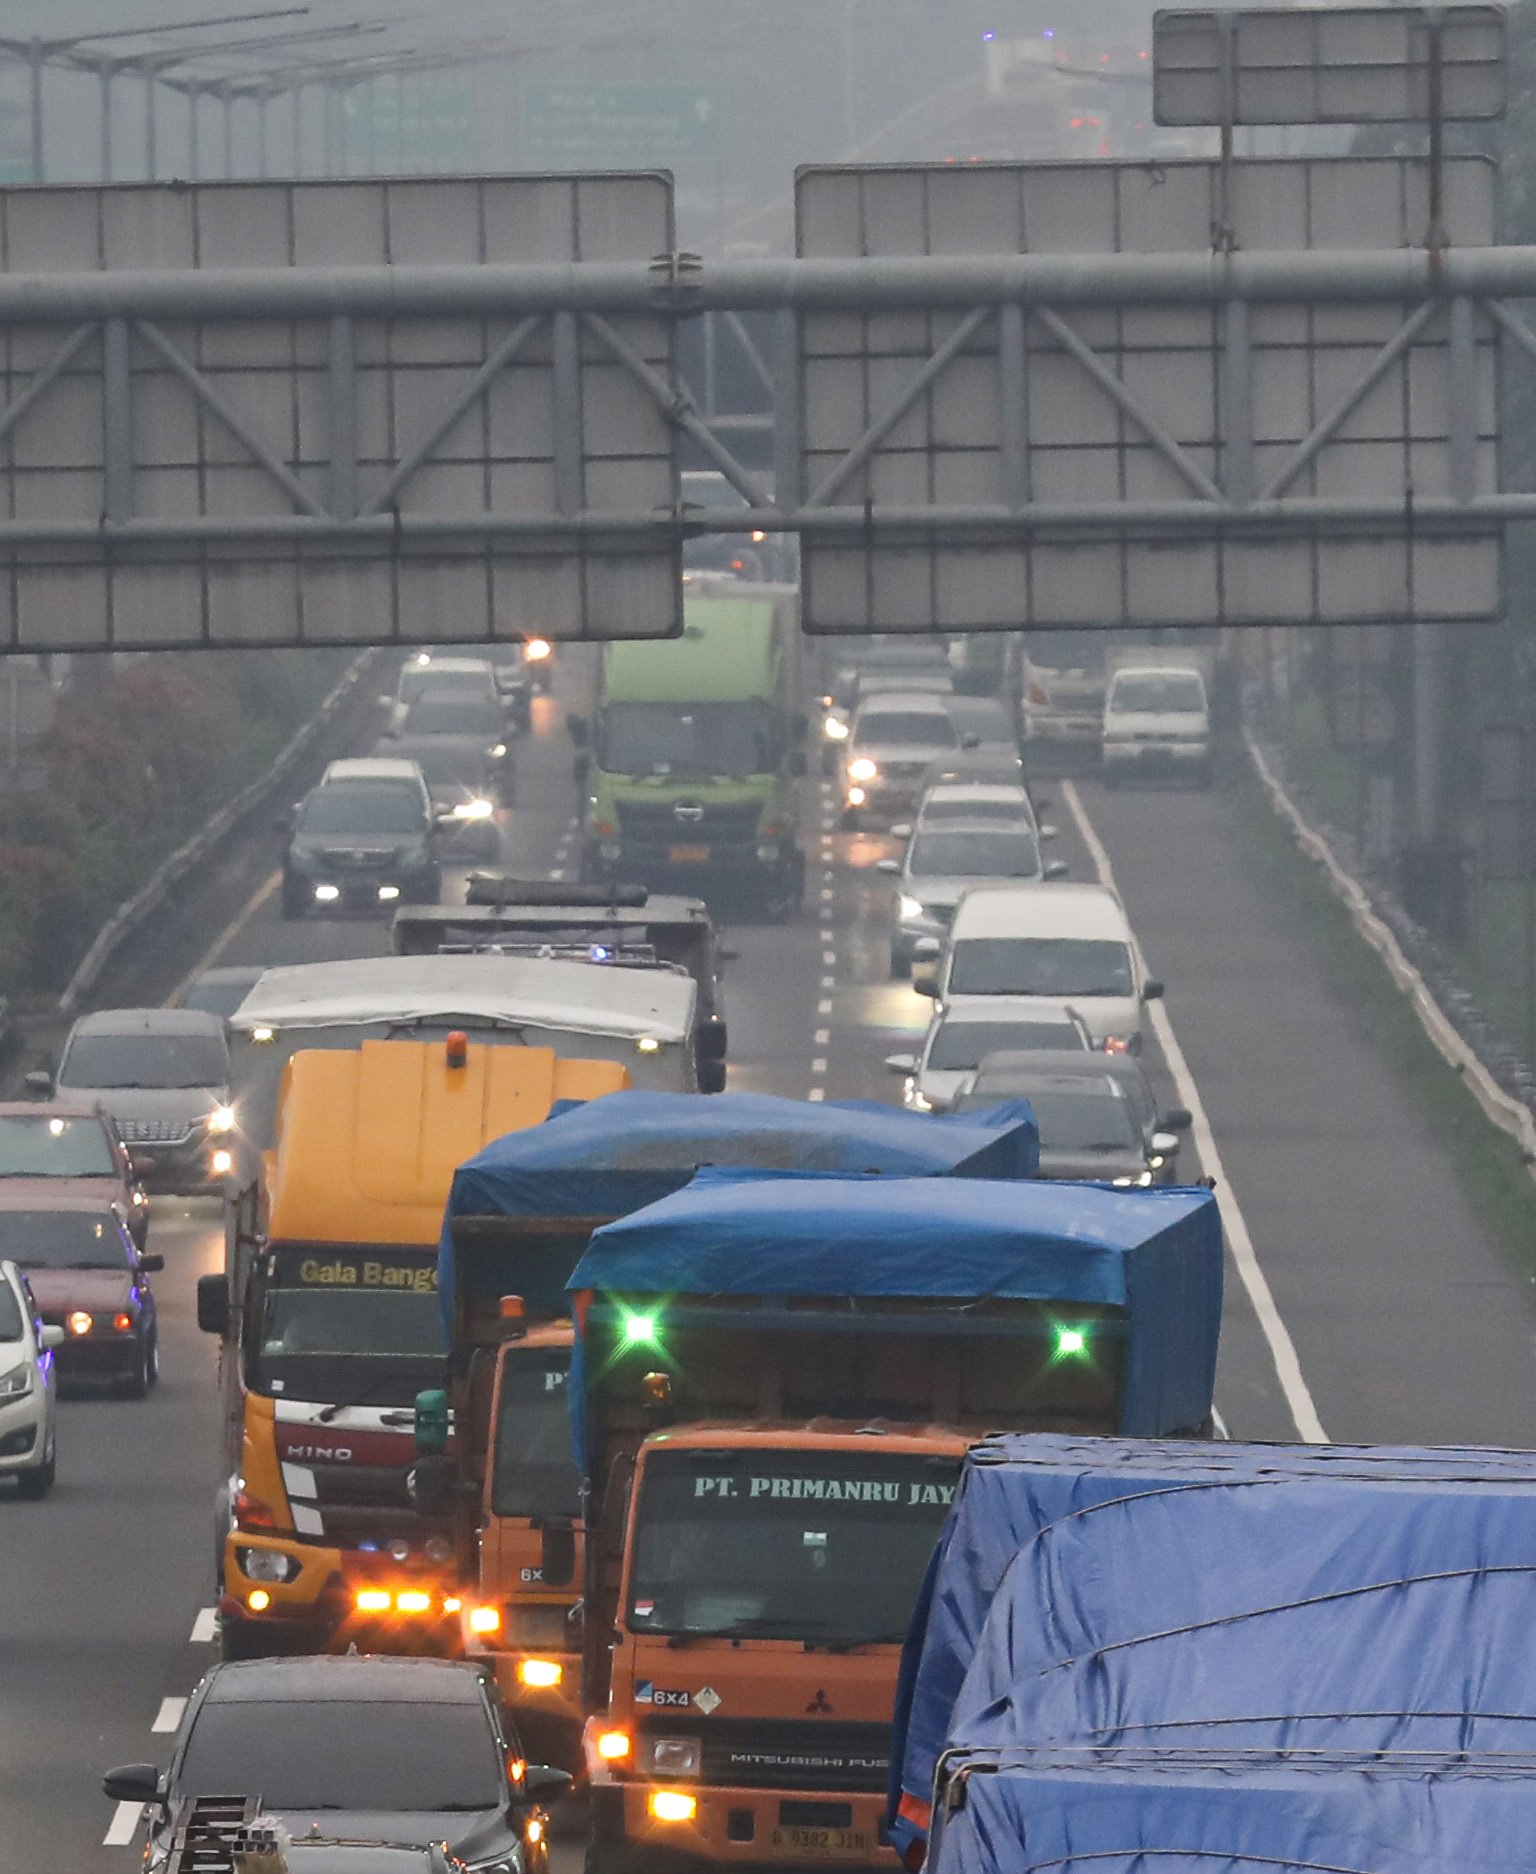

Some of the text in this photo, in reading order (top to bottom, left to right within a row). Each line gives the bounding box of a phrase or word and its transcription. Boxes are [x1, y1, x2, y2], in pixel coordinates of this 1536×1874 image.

[300, 1259, 357, 1283] Gala
[287, 1445, 352, 1460] HINO
[694, 1477, 956, 1505] PT. PRIMANRU JAY
[730, 1753, 889, 1768] MITSUBISHI FUS
